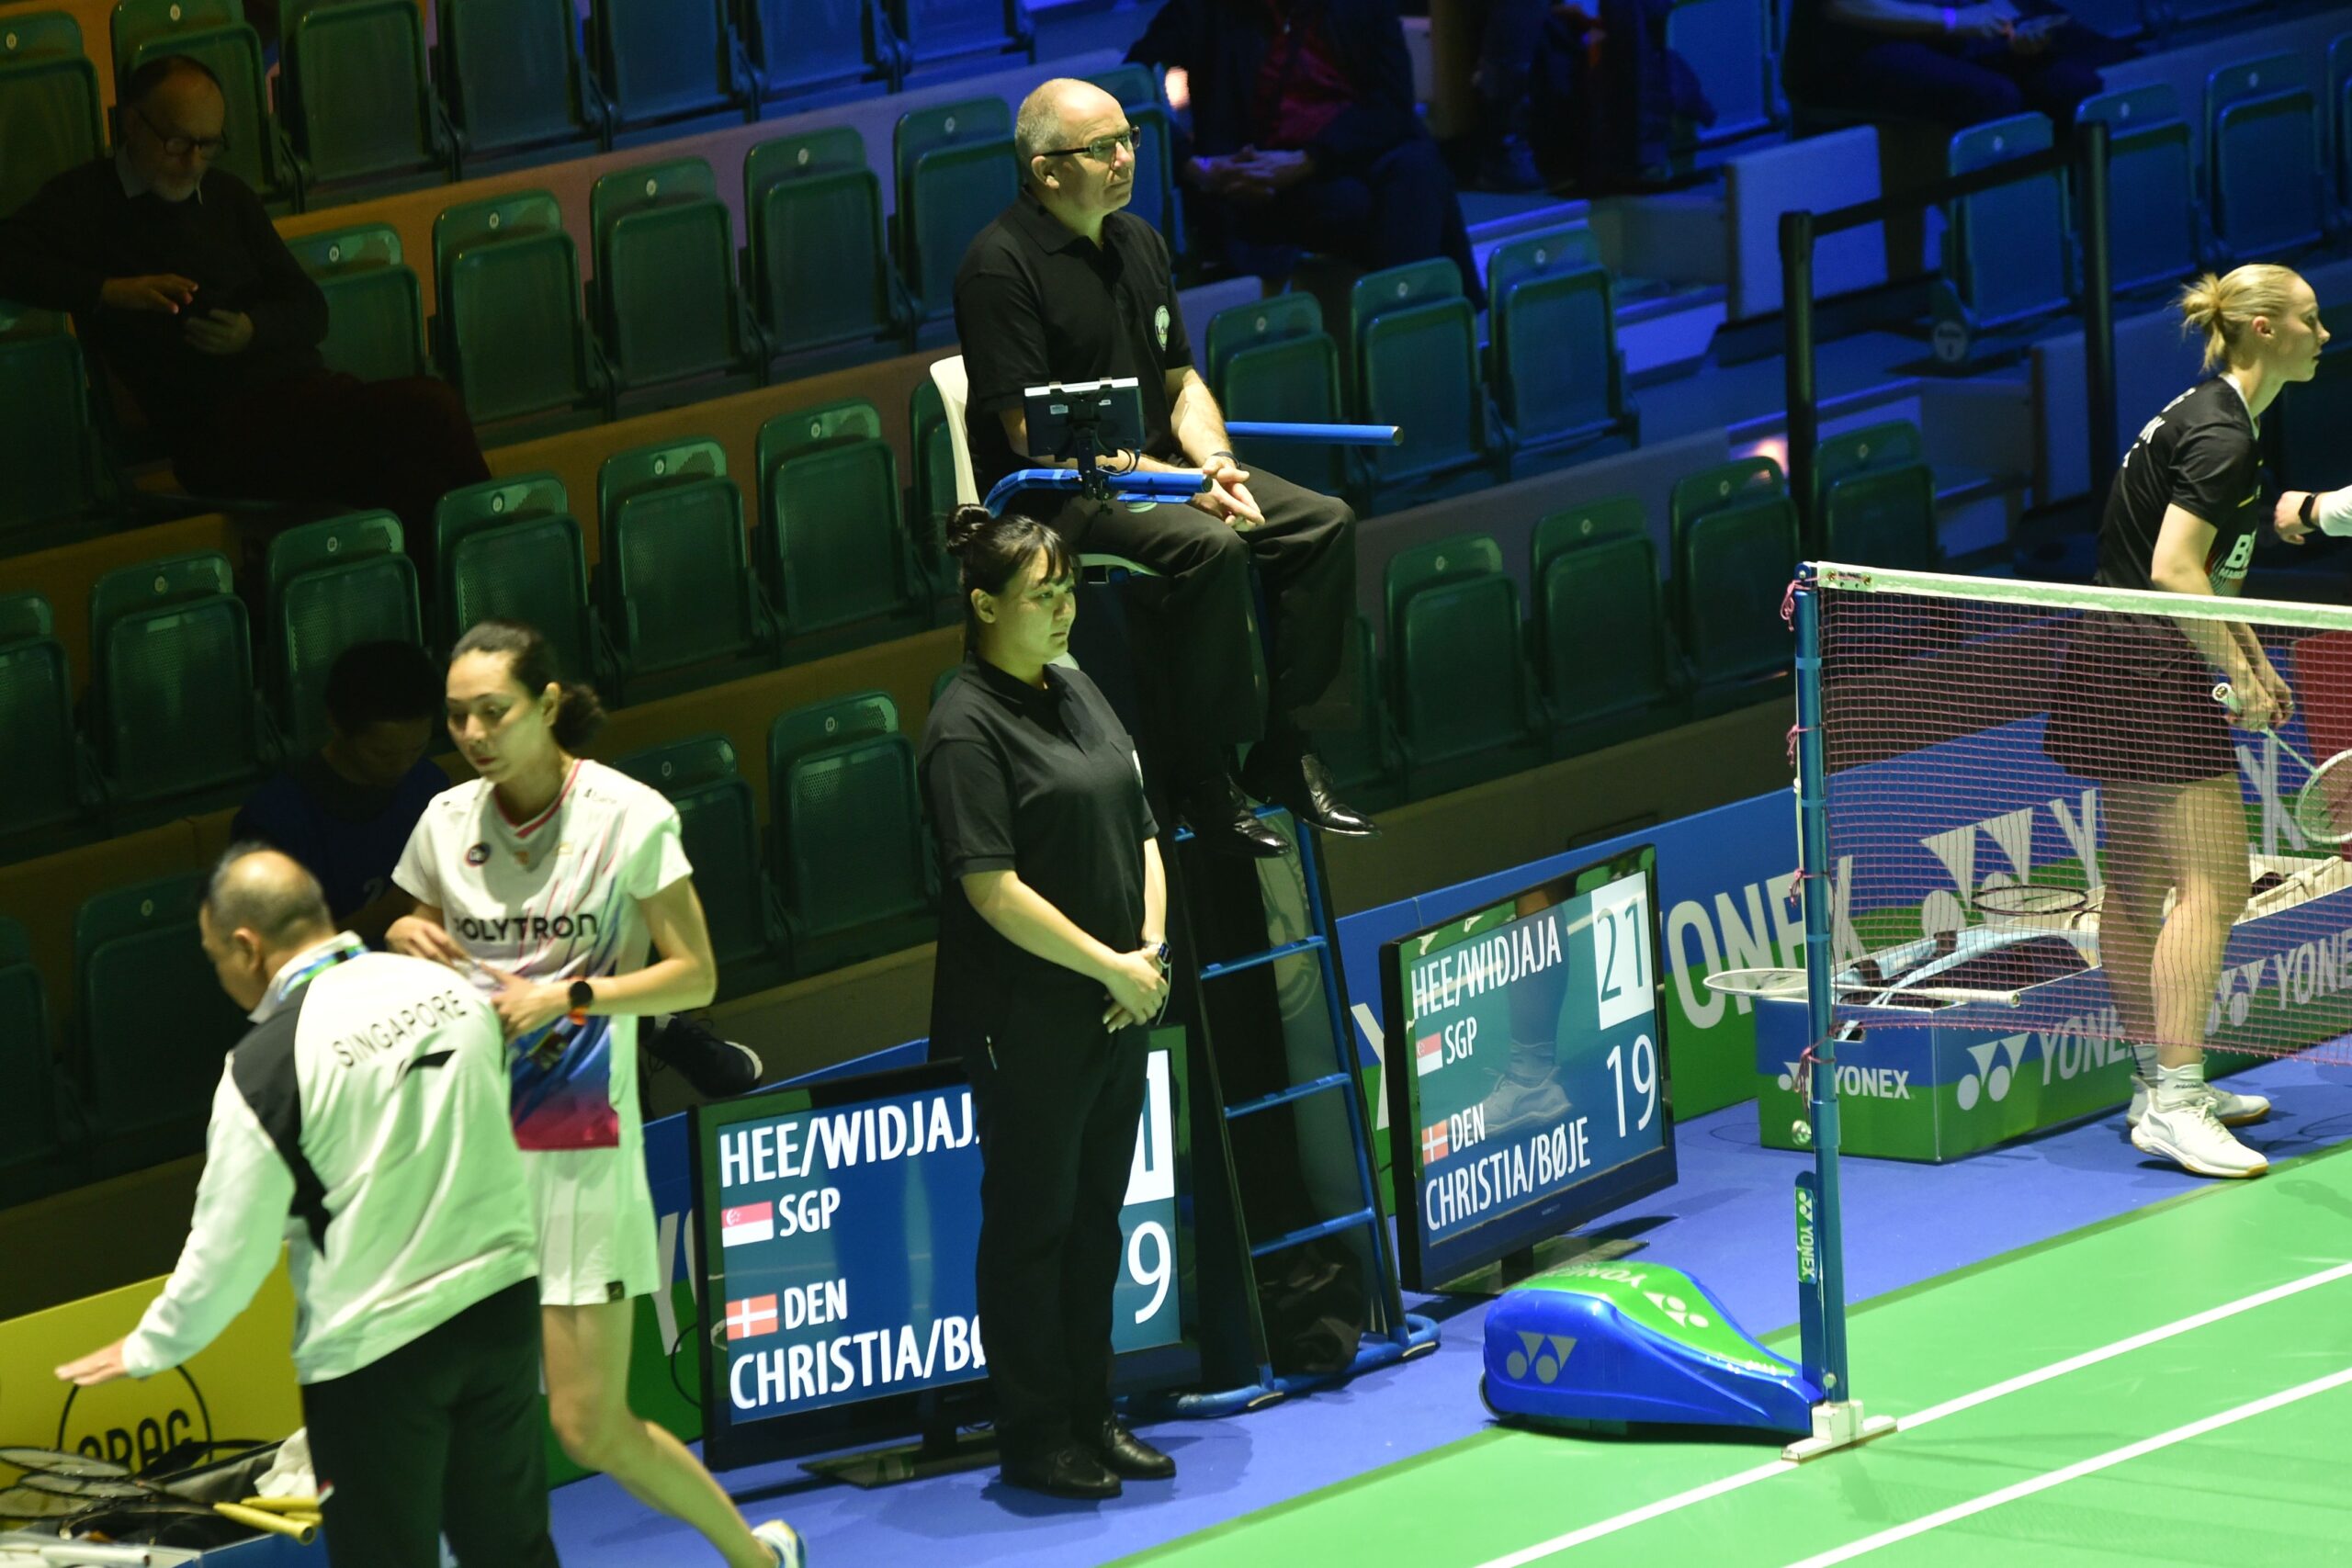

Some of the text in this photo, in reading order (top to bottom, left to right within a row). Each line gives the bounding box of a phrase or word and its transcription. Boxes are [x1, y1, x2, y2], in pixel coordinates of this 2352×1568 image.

[457, 913, 597, 942] OLYTRON
[1410, 915, 1562, 1020] HEE/WIDJAJA
[1597, 897, 1645, 1003] 21
[1660, 854, 1869, 1030] ONEX
[2273, 927, 2352, 1011] YONE
[332, 989, 467, 1068] SINGAPORE
[1444, 1016, 1477, 1066] SGP
[2037, 1002, 2133, 1087] YONE
[1606, 1033, 1656, 1138] 19
[1834, 1065, 1911, 1100] YONEX
[719, 1091, 981, 1189] HEE/WIDJAJ
[1450, 1103, 1487, 1153] DEN
[778, 1187, 842, 1237] SGP
[1425, 1116, 1591, 1232] CHRISTIA/BØJE
[1127, 1220, 1172, 1325] 9
[1799, 1225, 1815, 1278] YONEX
[784, 1278, 848, 1330] DEN
[729, 1314, 987, 1410] CHRISTIA/B
